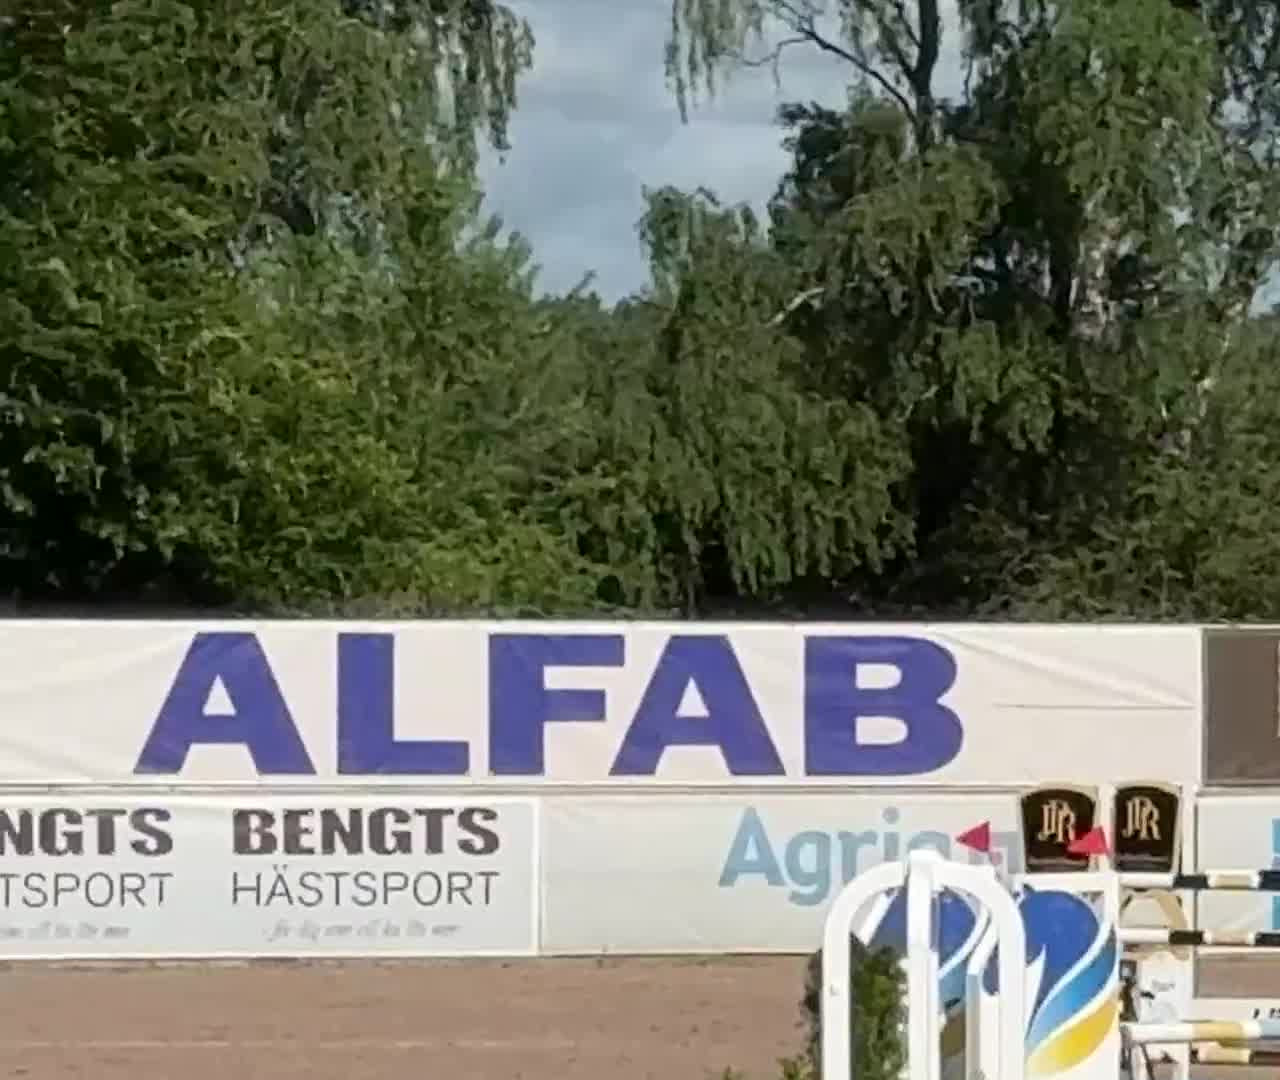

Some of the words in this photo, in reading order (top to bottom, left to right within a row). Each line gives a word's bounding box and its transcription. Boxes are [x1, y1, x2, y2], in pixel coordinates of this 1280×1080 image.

[133, 631, 963, 776] ALFAB
[233, 807, 500, 856] BENGTS
[233, 864, 500, 906] HÄSTSPORT
